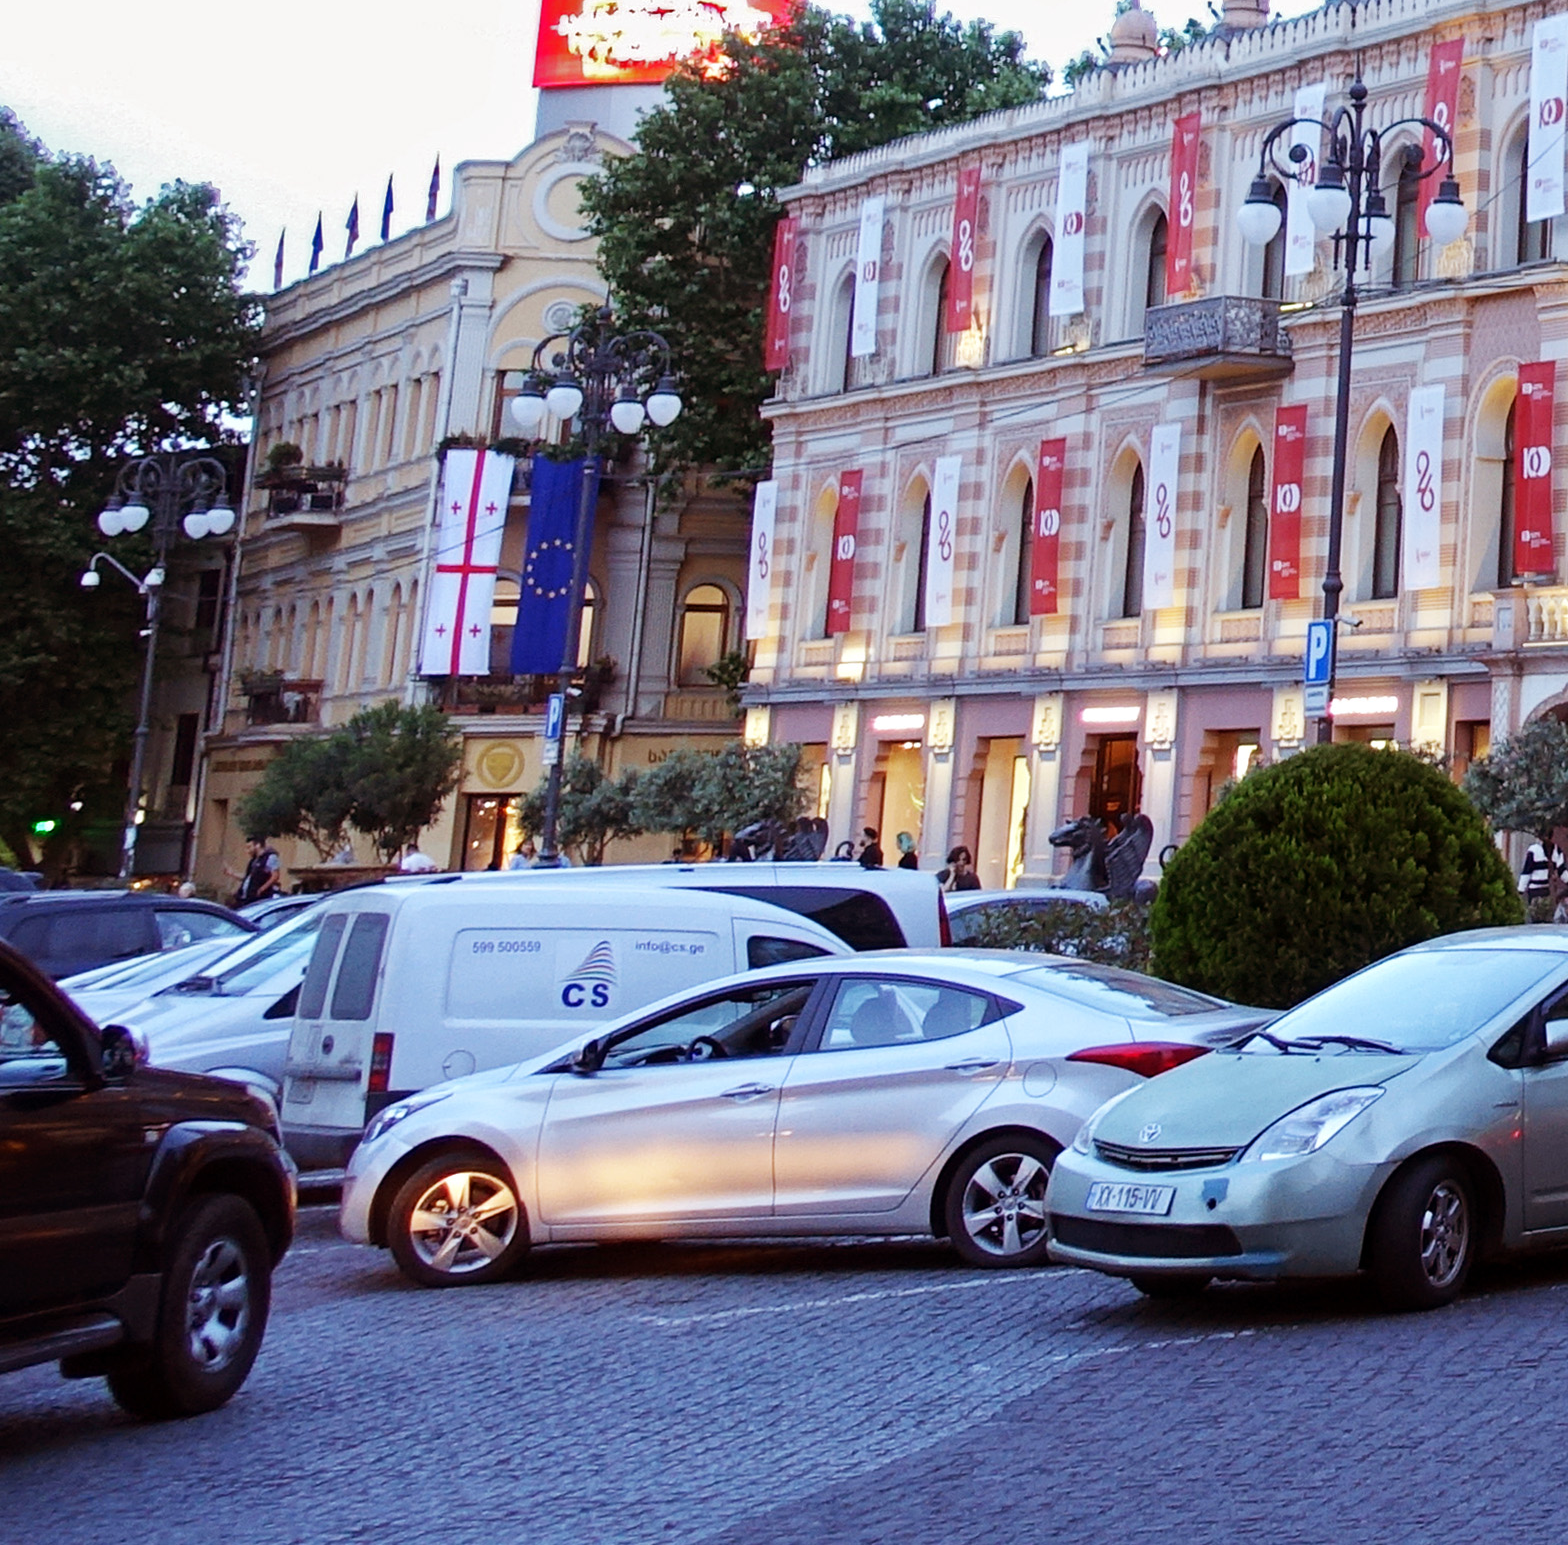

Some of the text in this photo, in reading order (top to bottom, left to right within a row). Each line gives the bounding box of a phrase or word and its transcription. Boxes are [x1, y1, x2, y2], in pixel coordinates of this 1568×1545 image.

[1541, 97, 1564, 130] 100
[959, 220, 973, 272] 26
[1523, 446, 1552, 479] 100
[1276, 483, 1301, 515] 100
[1416, 450, 1435, 513] 26
[1156, 483, 1171, 539] 26
[939, 510, 951, 561] 26
[1308, 625, 1327, 679] P
[547, 698, 560, 738] P
[472, 941, 541, 954] 599 500559
[635, 940, 705, 954] info@cs.ge
[561, 983, 610, 1008] CS
